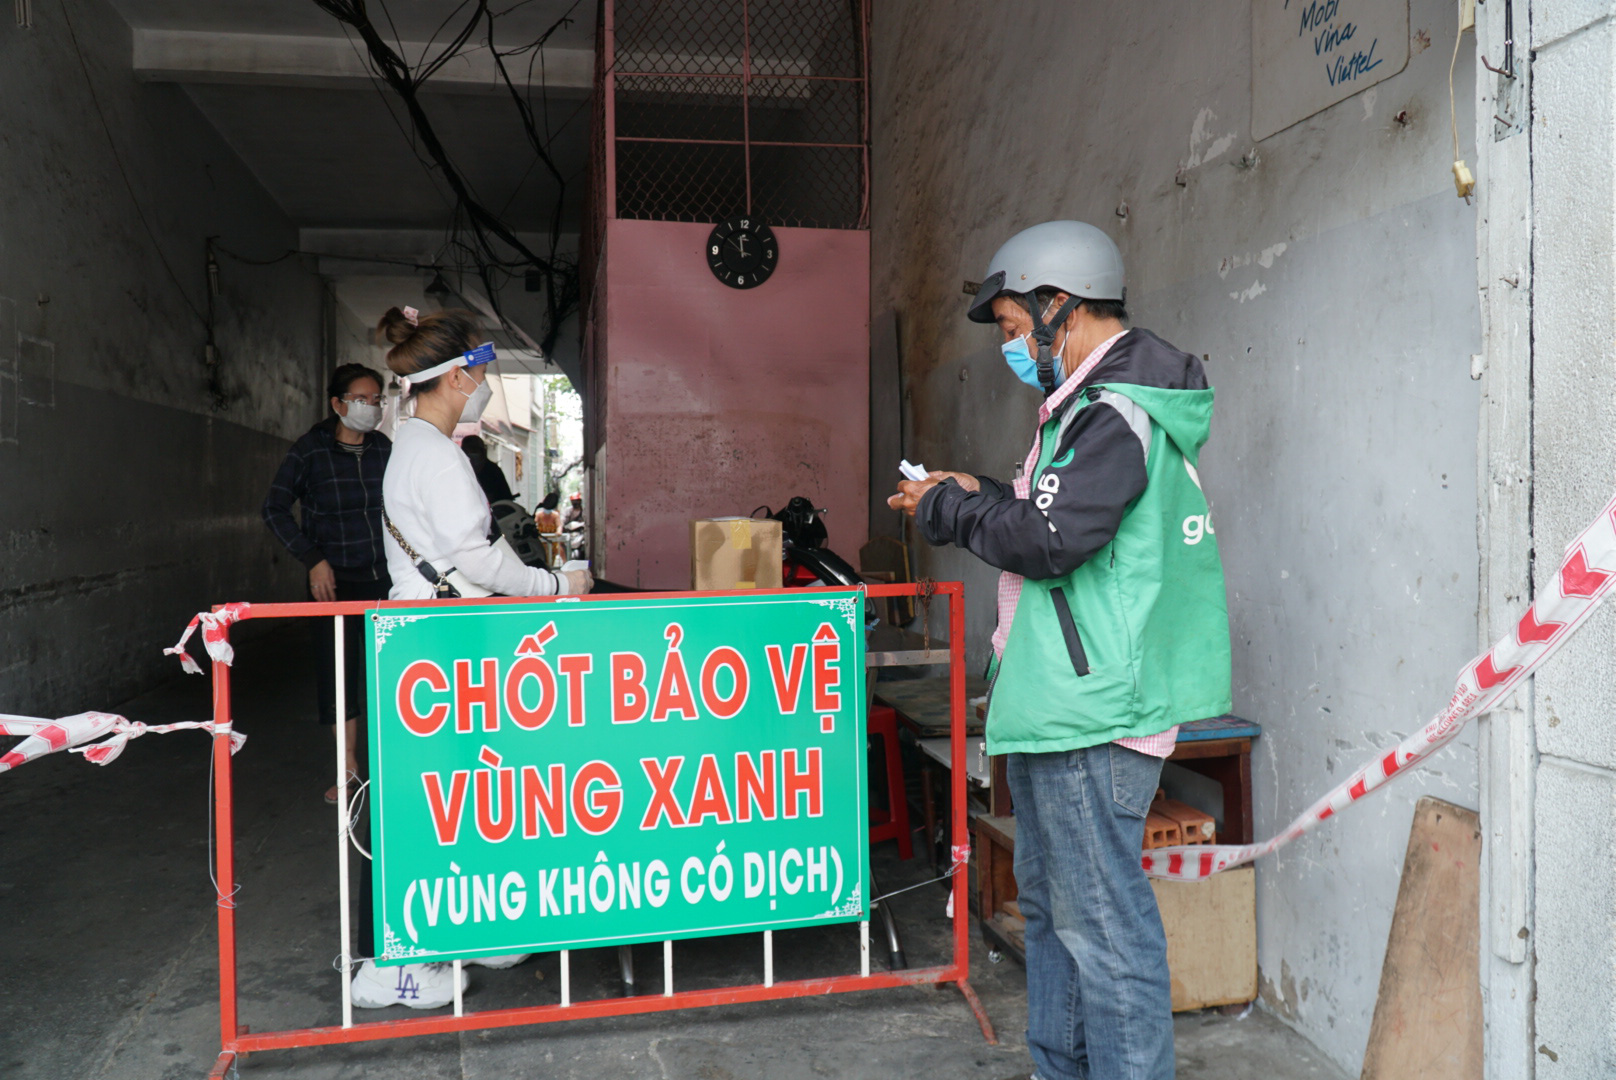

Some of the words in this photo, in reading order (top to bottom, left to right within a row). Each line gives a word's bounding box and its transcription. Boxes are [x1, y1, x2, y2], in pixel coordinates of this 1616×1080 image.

[1314, 22, 1357, 56] Vina
[740, 219, 749, 229] 12
[712, 245, 719, 255] 9
[766, 249, 773, 259] 3
[737, 275, 745, 285] 6
[396, 620, 593, 737] CHỐT
[609, 622, 750, 724] BẢO
[765, 622, 842, 733] VỆ
[421, 745, 623, 846] VÙNG
[639, 747, 823, 831] XANH
[403, 861, 527, 944] (VÙNG
[538, 850, 670, 918] KHÔNG
[680, 840, 733, 904] CÓ
[744, 845, 844, 910] DỊCH)
[395, 965, 419, 999] LA
